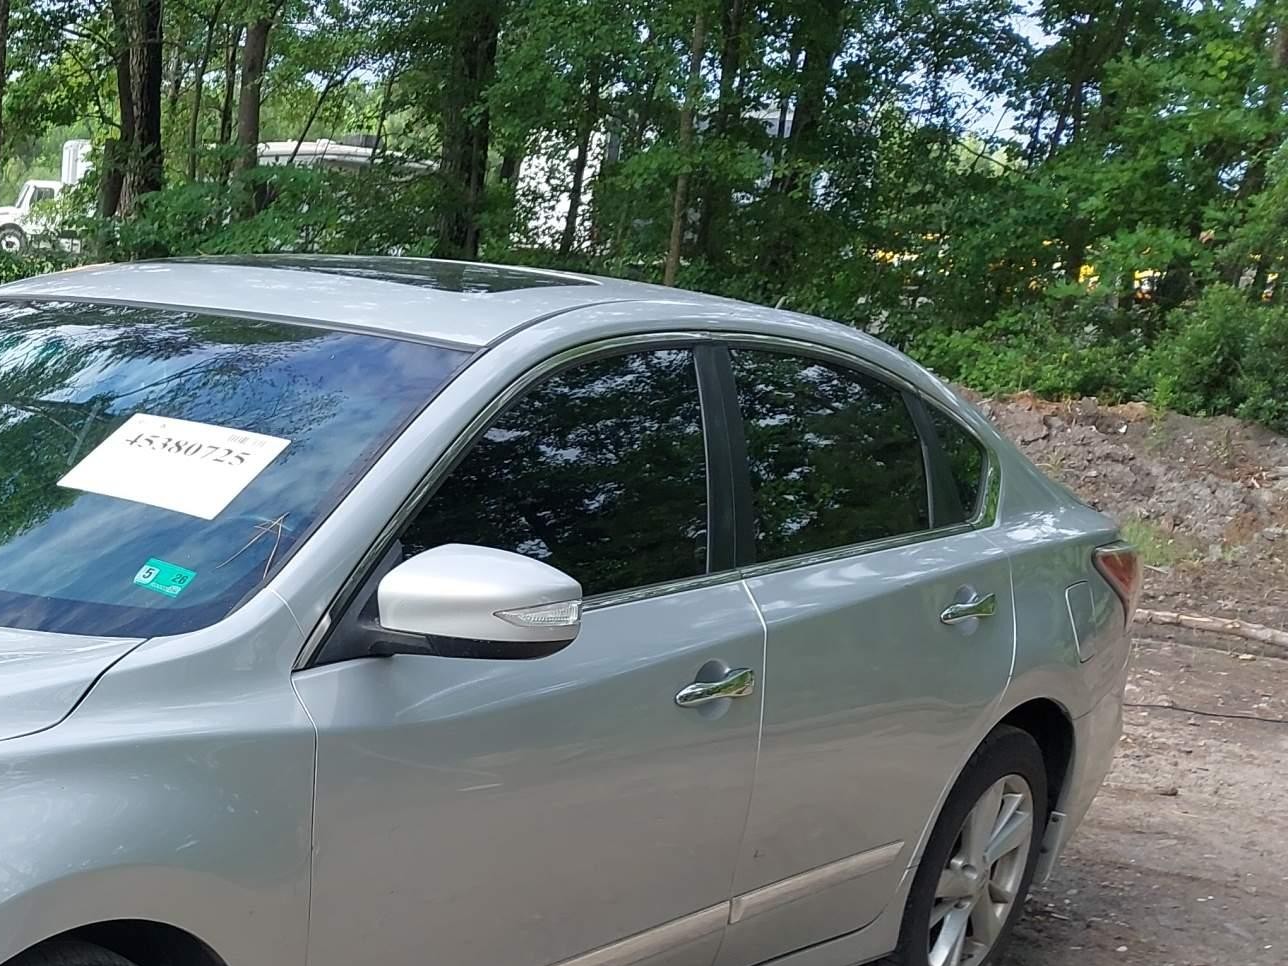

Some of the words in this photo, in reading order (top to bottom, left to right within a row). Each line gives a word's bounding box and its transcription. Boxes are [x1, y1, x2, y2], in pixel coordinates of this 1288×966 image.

[124, 432, 252, 466] 45380725
[142, 567, 155, 579] 5
[172, 573, 189, 585] 26
